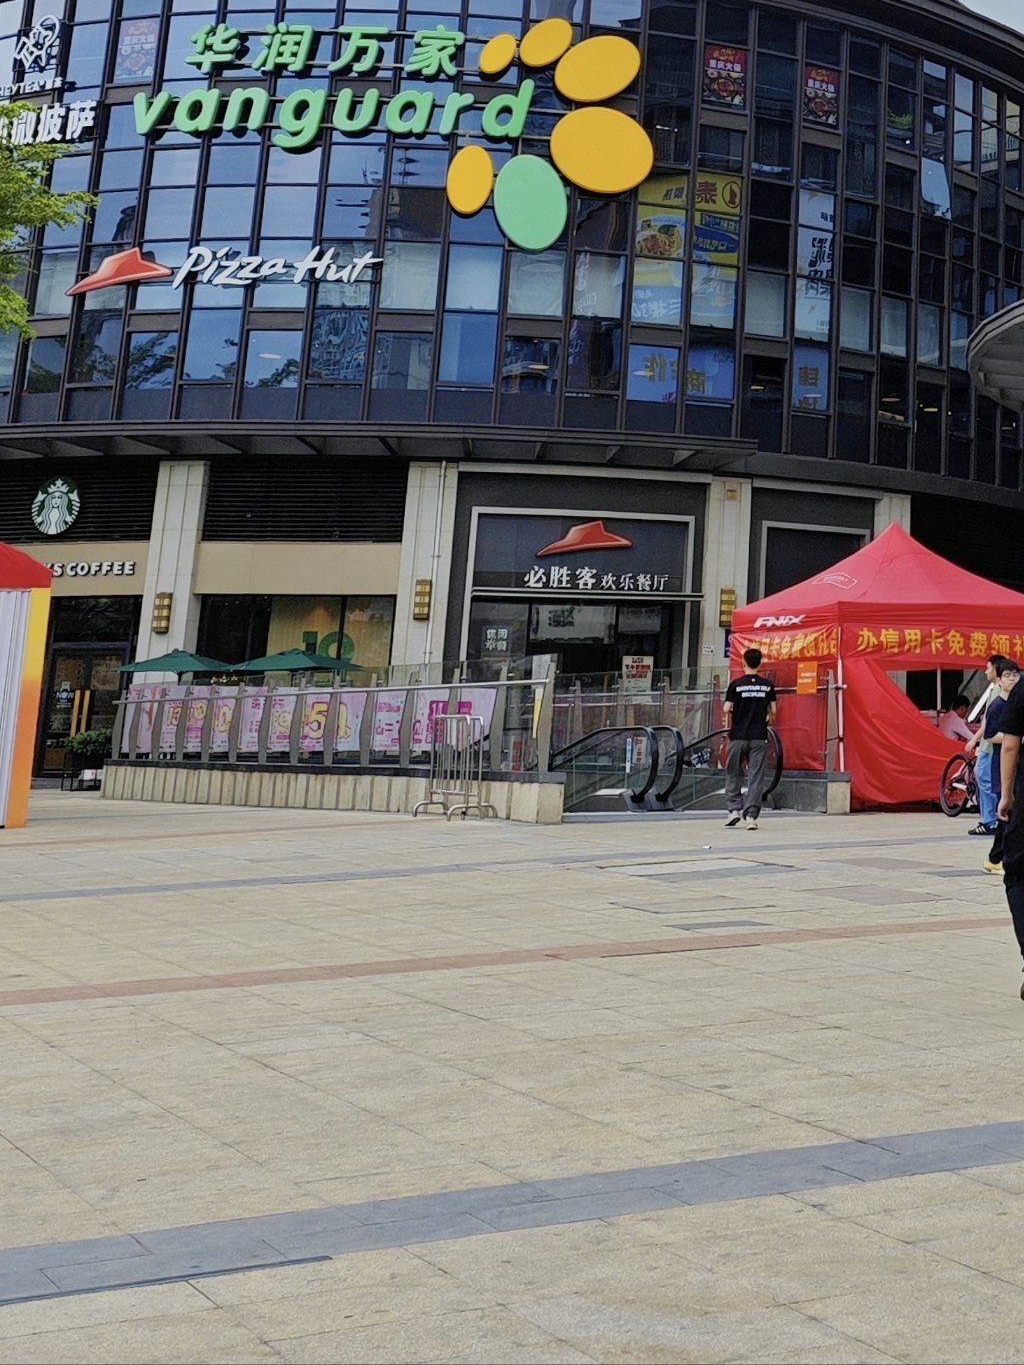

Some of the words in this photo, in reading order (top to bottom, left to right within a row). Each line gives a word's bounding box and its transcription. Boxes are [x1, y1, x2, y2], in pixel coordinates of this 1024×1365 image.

[185, 22, 465, 77] 华润万家
[133, 78, 535, 149] vanguard
[172, 246, 287, 289] Pizza
[293, 245, 384, 284] Hut
[66, 561, 135, 576] COFFEE
[524, 565, 598, 590] 必胜客
[600, 573, 669, 591] 欢乐餐厅
